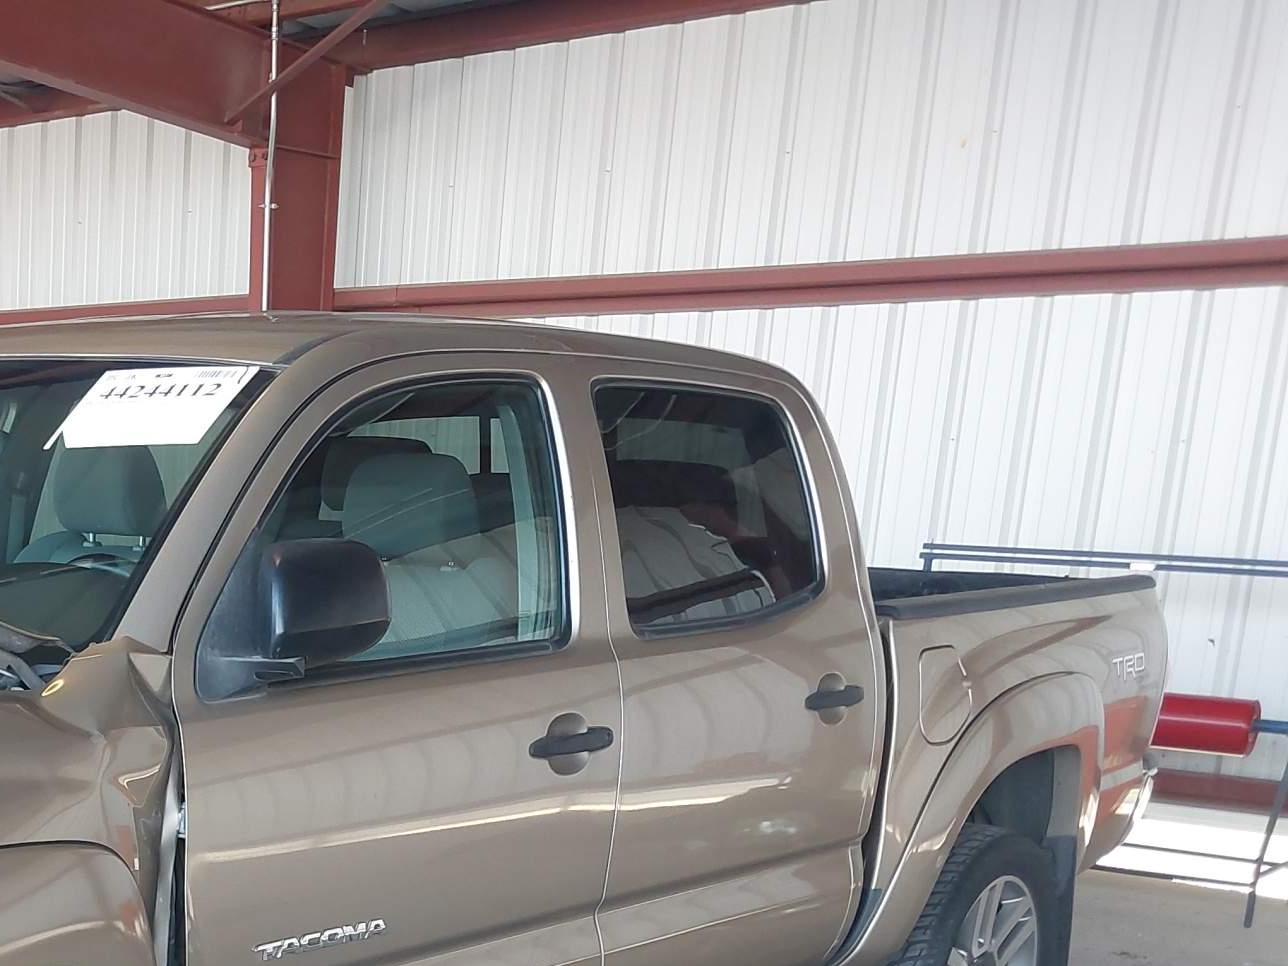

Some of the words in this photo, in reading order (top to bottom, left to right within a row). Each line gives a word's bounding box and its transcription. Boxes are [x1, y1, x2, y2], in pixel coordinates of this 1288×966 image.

[99, 383, 223, 400] 44244112
[1111, 652, 1145, 681] TRD
[253, 917, 387, 961] TACOMA
